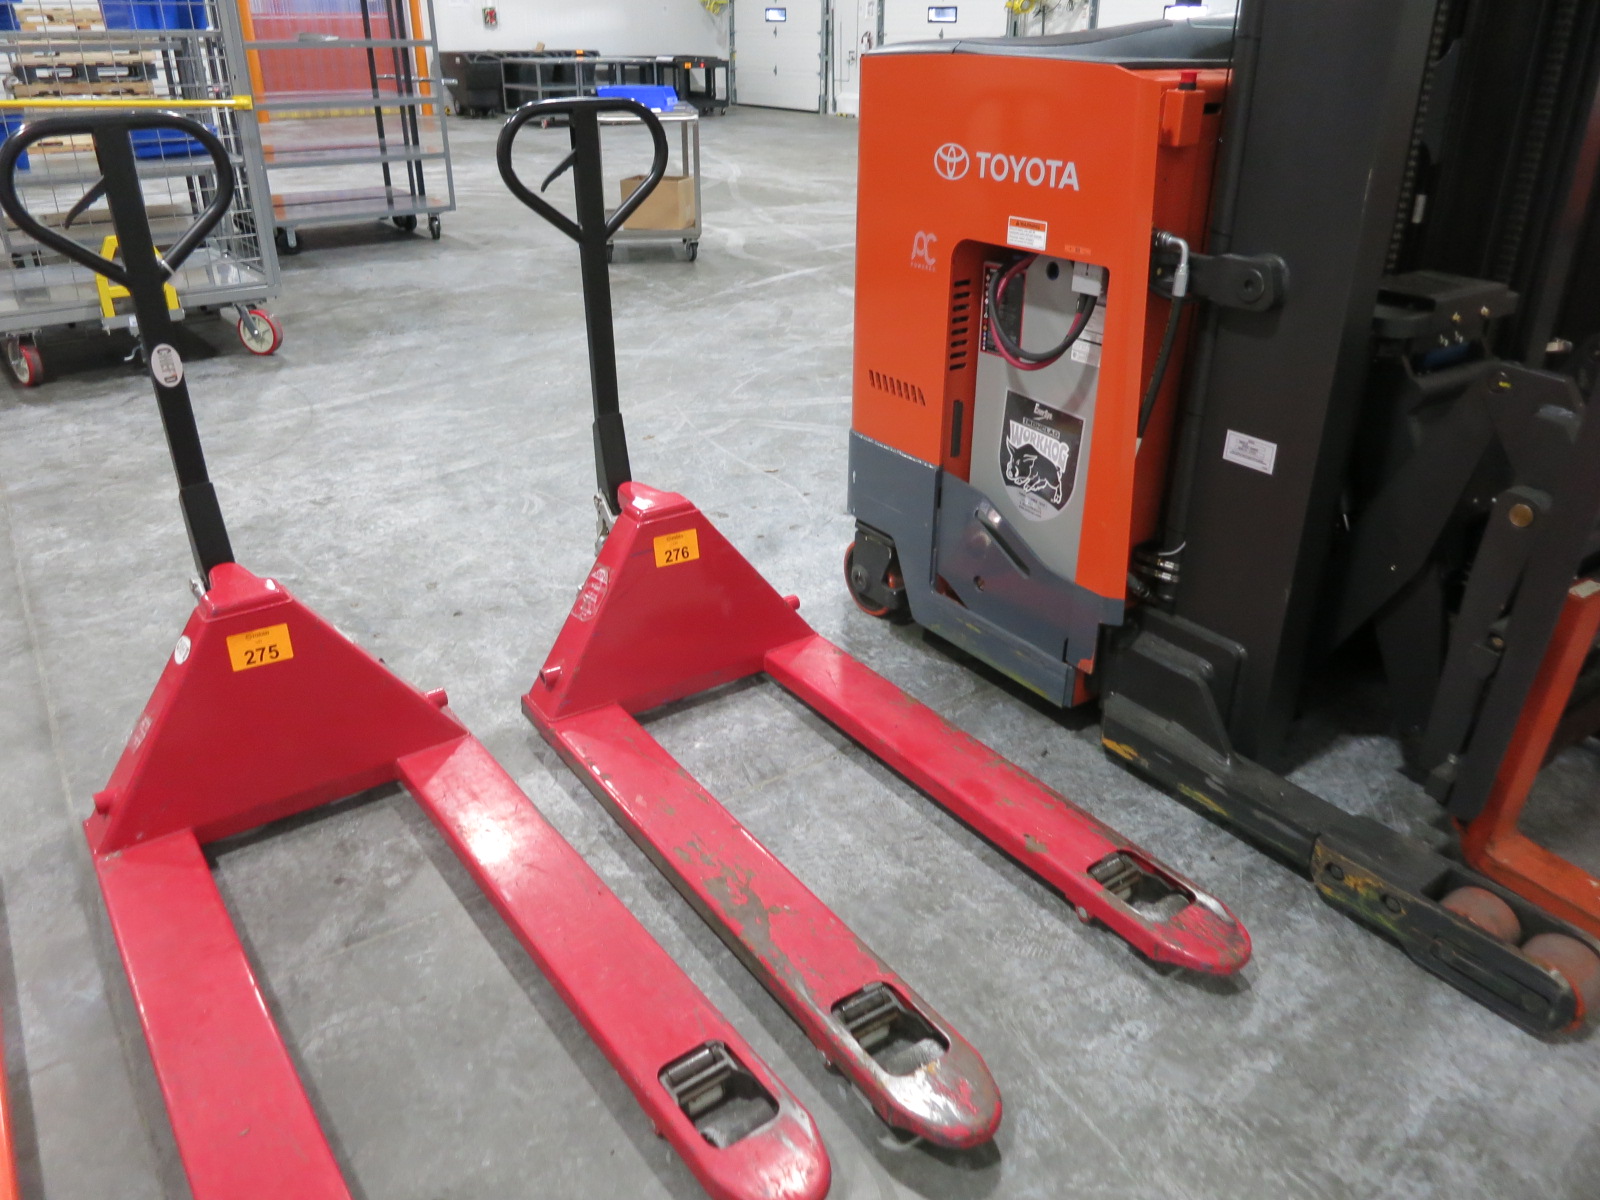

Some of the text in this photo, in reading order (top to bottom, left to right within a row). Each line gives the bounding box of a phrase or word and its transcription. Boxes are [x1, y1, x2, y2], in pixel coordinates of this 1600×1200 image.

[976, 151, 1080, 191] TOYOTA
[1010, 420, 1069, 472] WORKHOG
[664, 546, 690, 563] 276
[244, 644, 280, 665] 275
